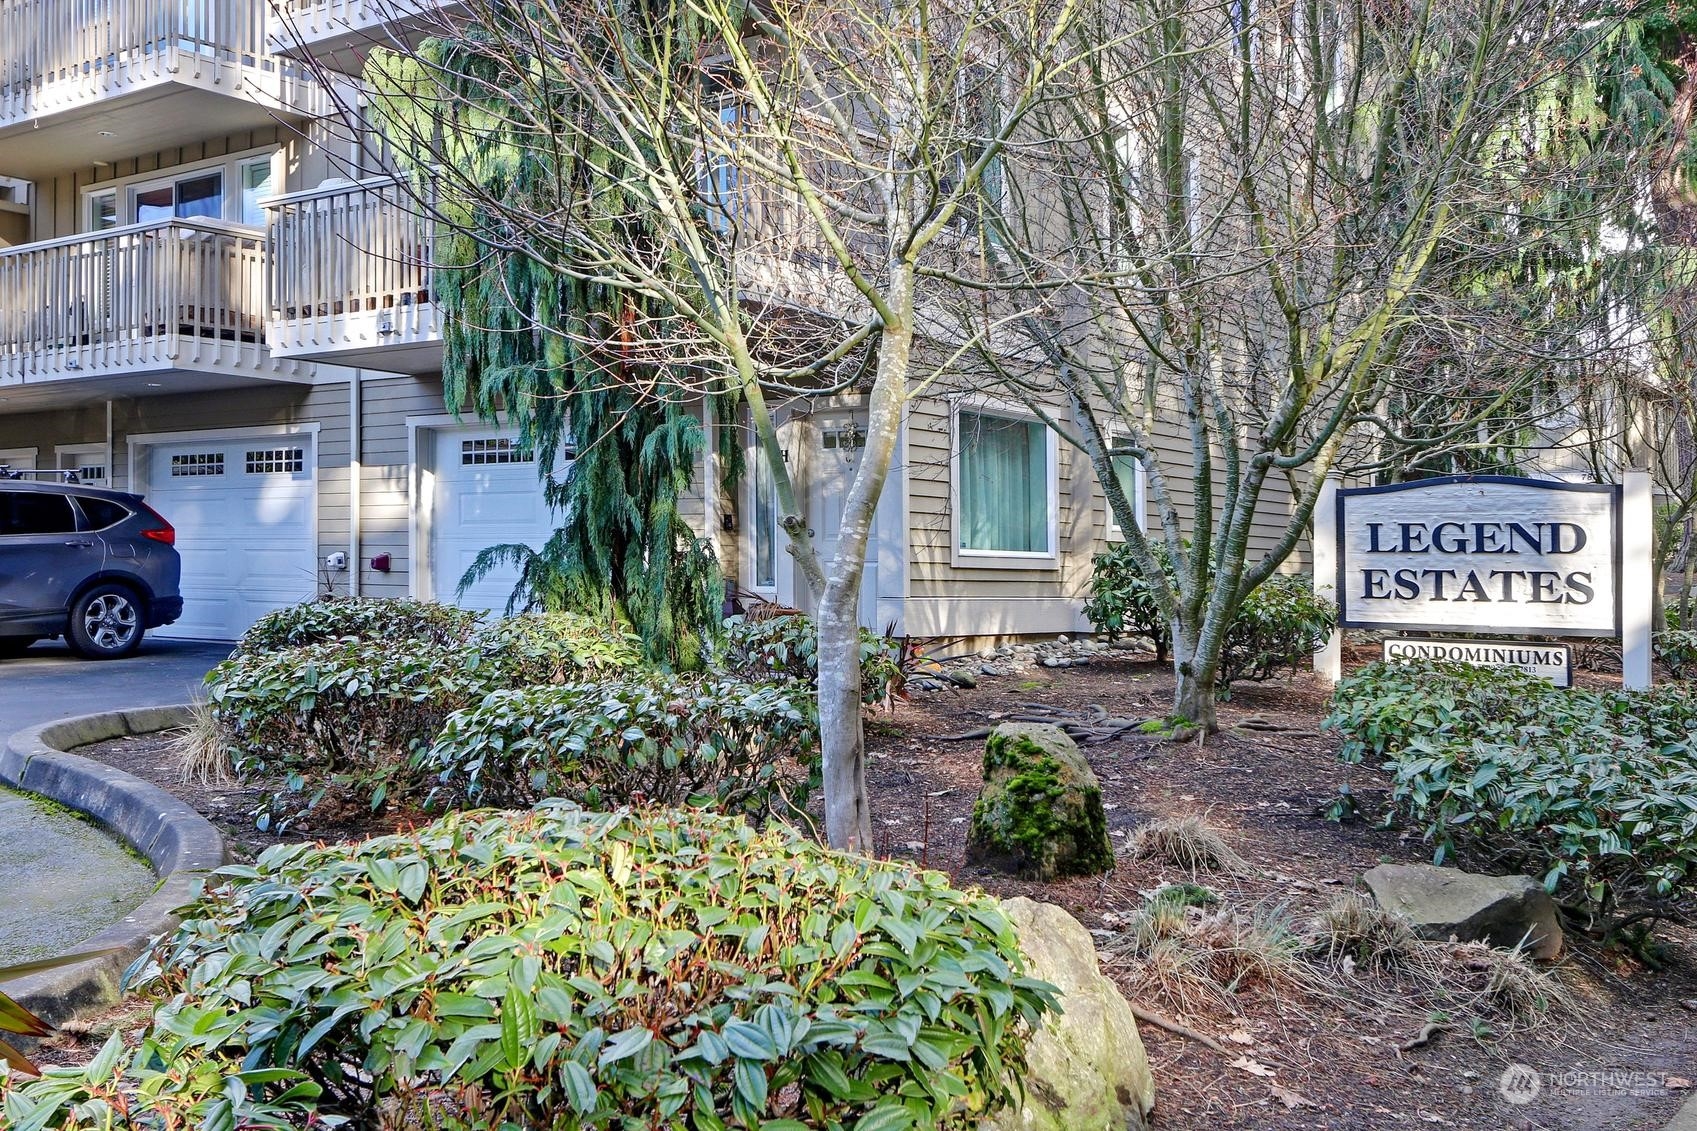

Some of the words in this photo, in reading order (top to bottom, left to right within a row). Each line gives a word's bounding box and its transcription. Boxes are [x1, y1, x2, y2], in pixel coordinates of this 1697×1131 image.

[1366, 522, 1587, 556] LEGEND
[1360, 568, 1595, 605] ESTATES
[1389, 643, 1564, 666] CONDOMINIUMS
